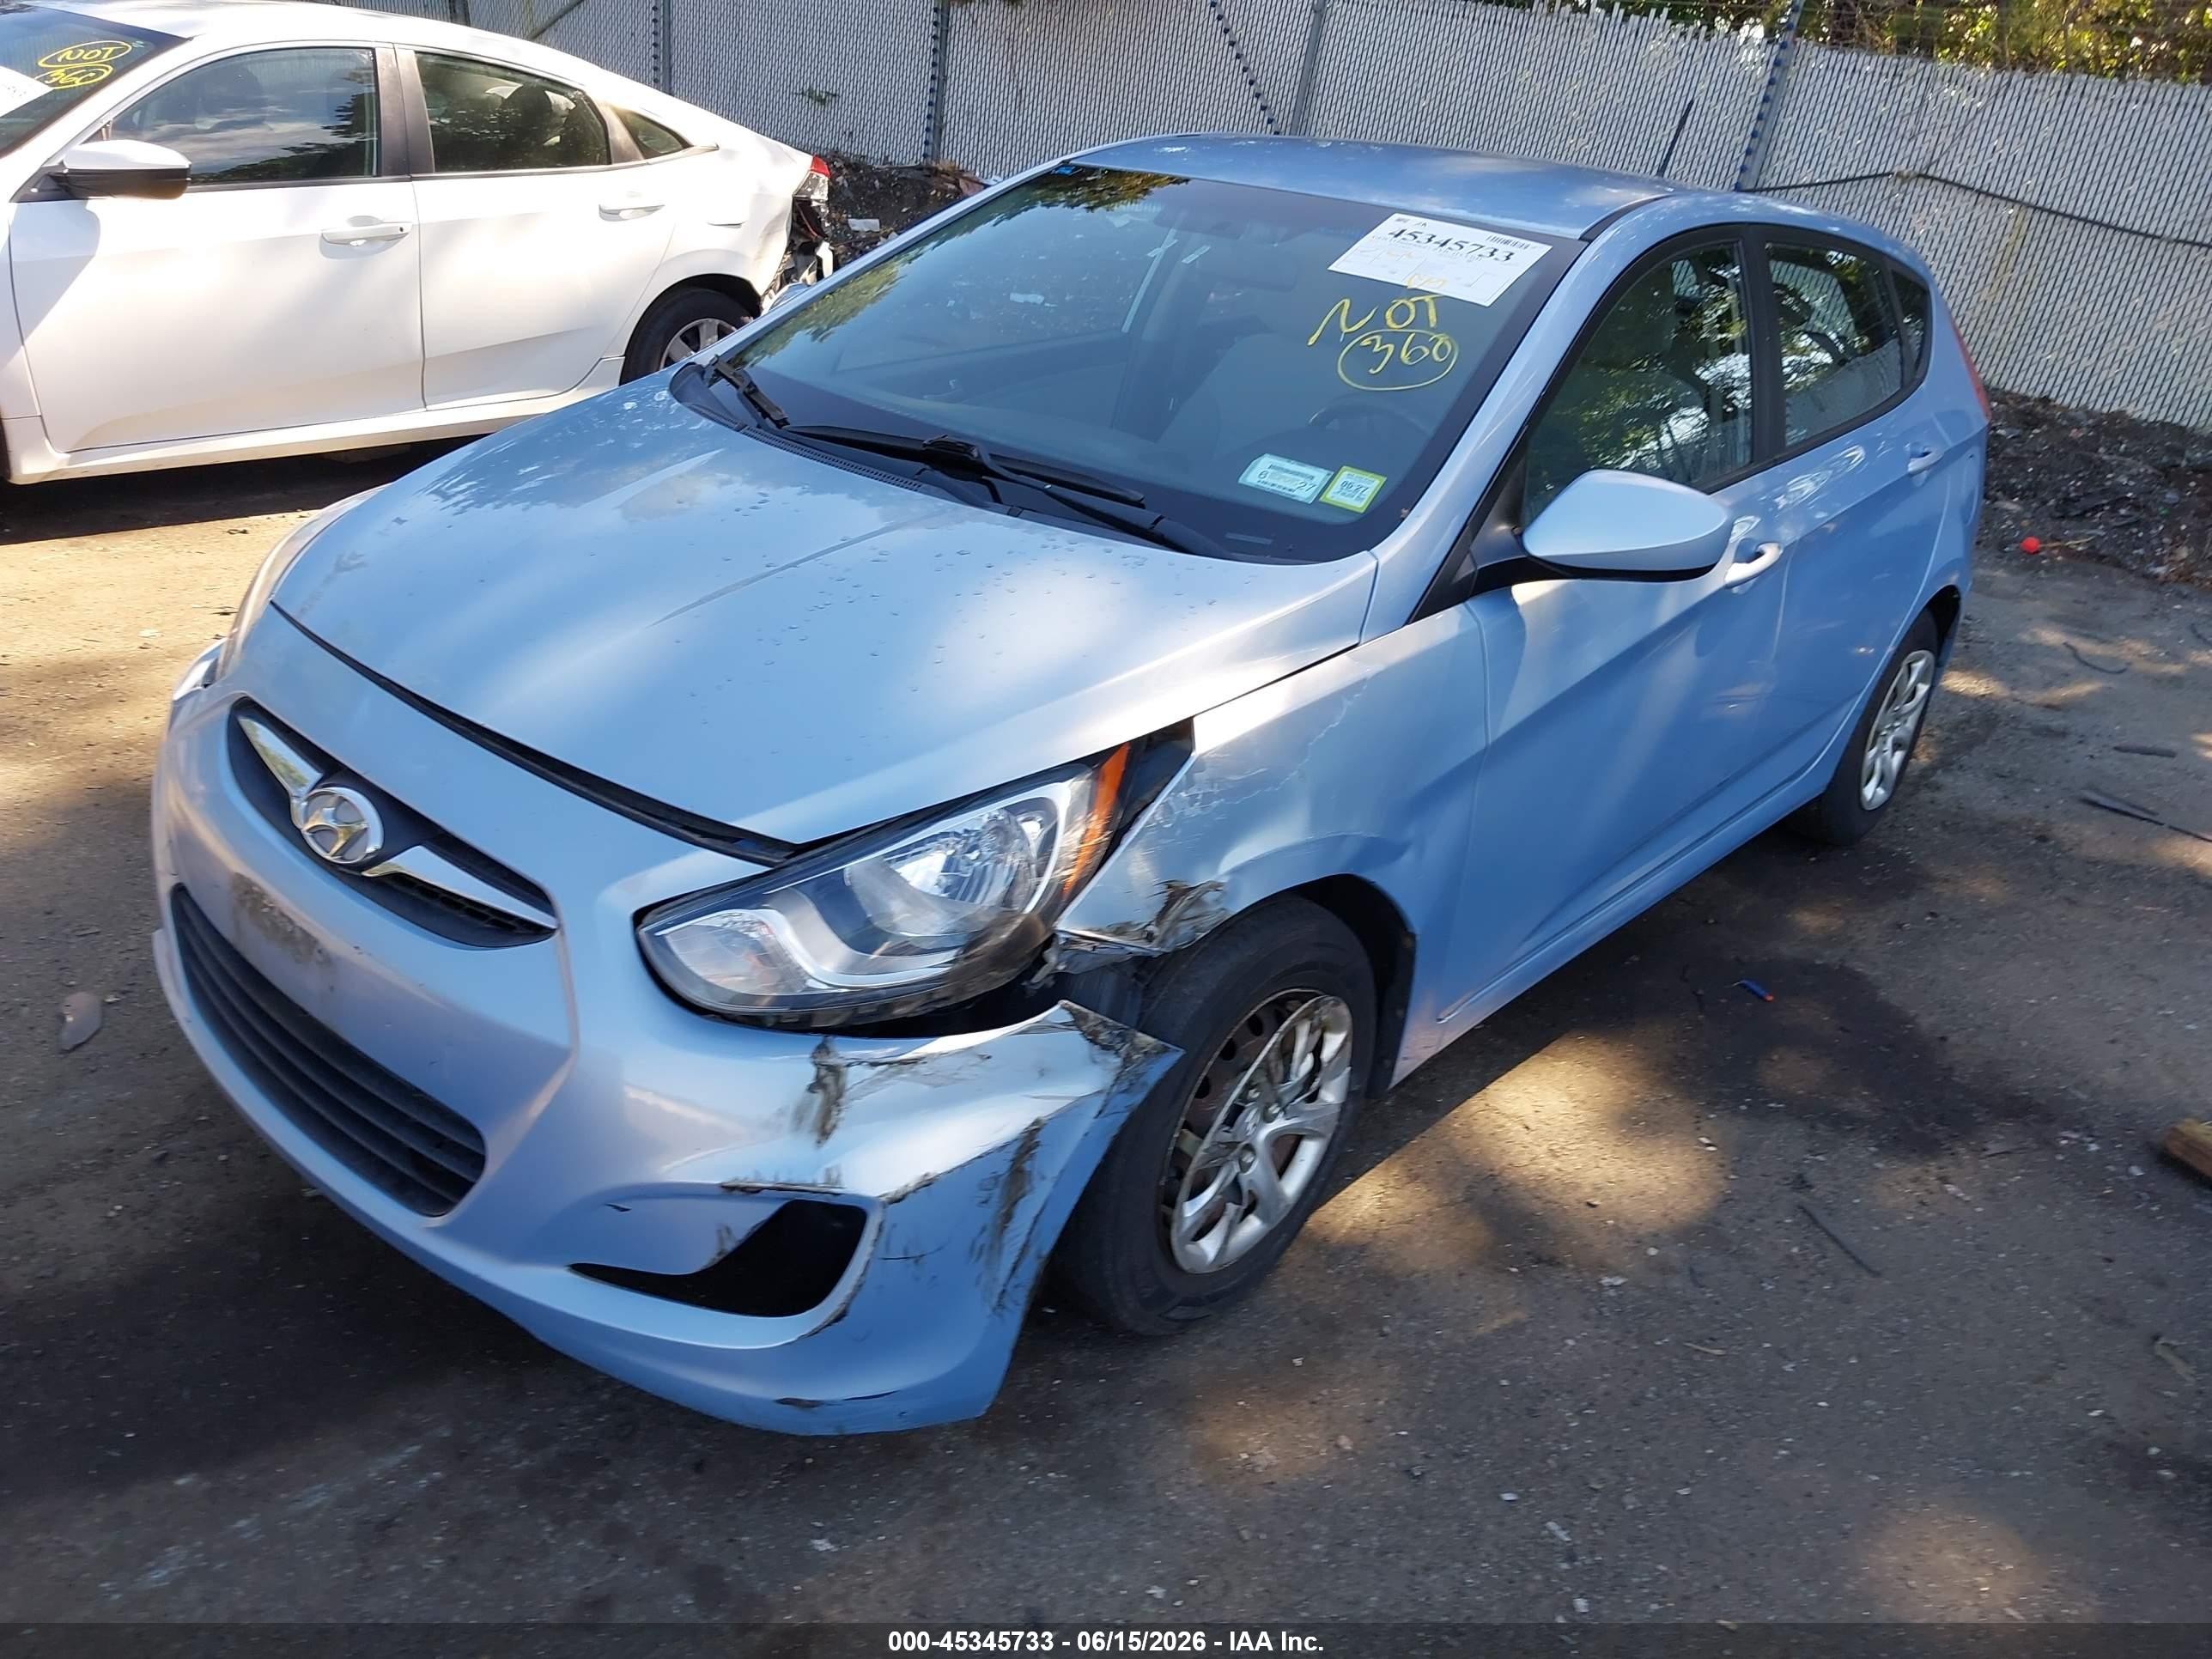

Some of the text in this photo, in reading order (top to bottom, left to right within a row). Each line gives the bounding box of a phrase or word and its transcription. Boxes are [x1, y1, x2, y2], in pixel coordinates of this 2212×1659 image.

[57, 46, 127, 63] NOT
[1388, 228, 1516, 263] 45345733
[1307, 294, 1443, 346] NOT
[1359, 332, 1453, 374] 360
